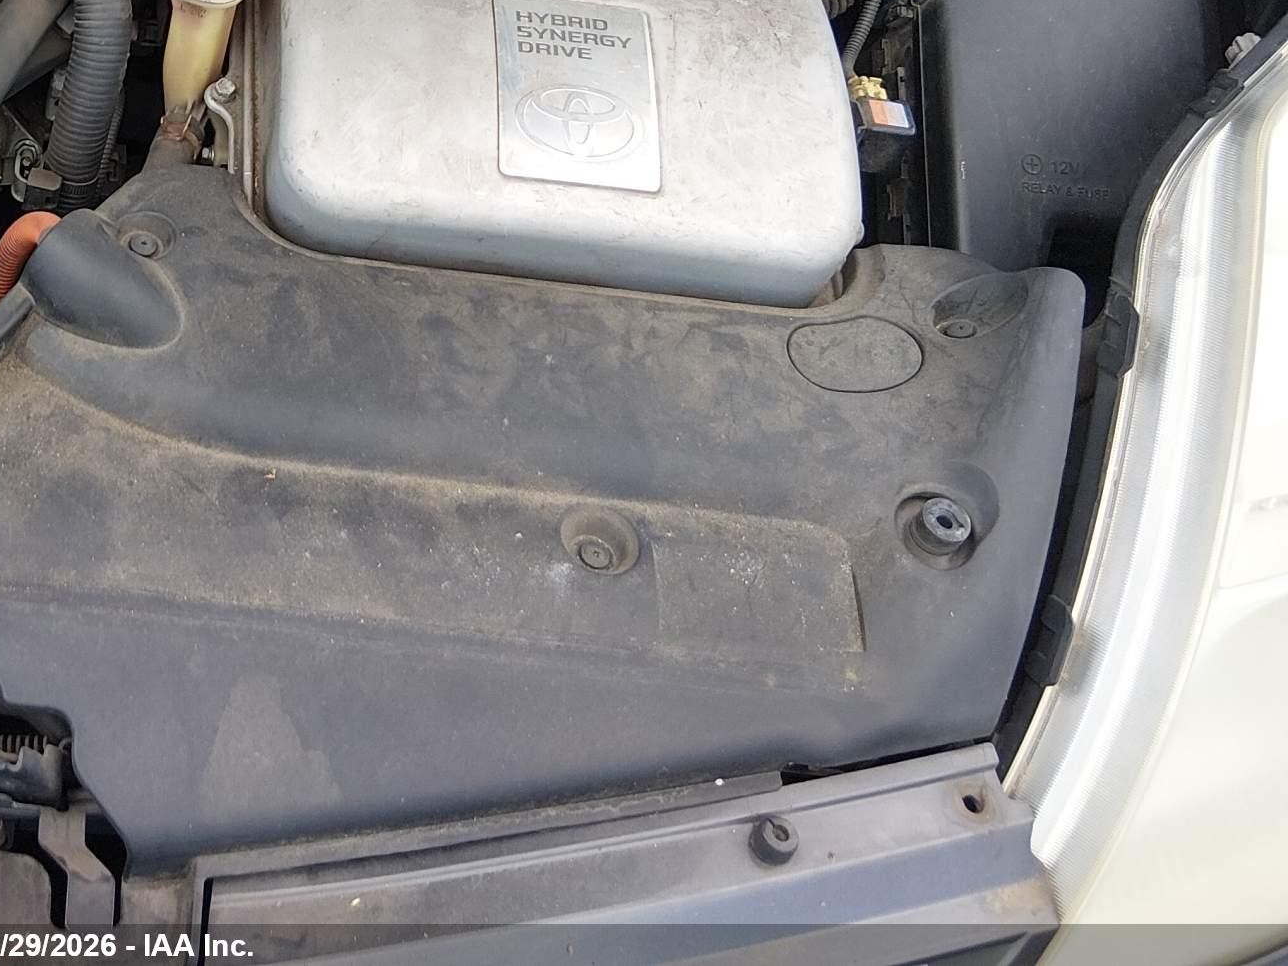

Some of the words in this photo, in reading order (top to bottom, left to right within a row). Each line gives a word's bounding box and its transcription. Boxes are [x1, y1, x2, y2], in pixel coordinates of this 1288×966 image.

[515, 10, 608, 31] HYBRID
[516, 25, 633, 49] SYNERGY
[517, 40, 593, 60] DRIVE
[1048, 160, 1080, 176] 12V
[1021, 181, 1061, 195] RELAY
[1077, 186, 1110, 201] FUSE
